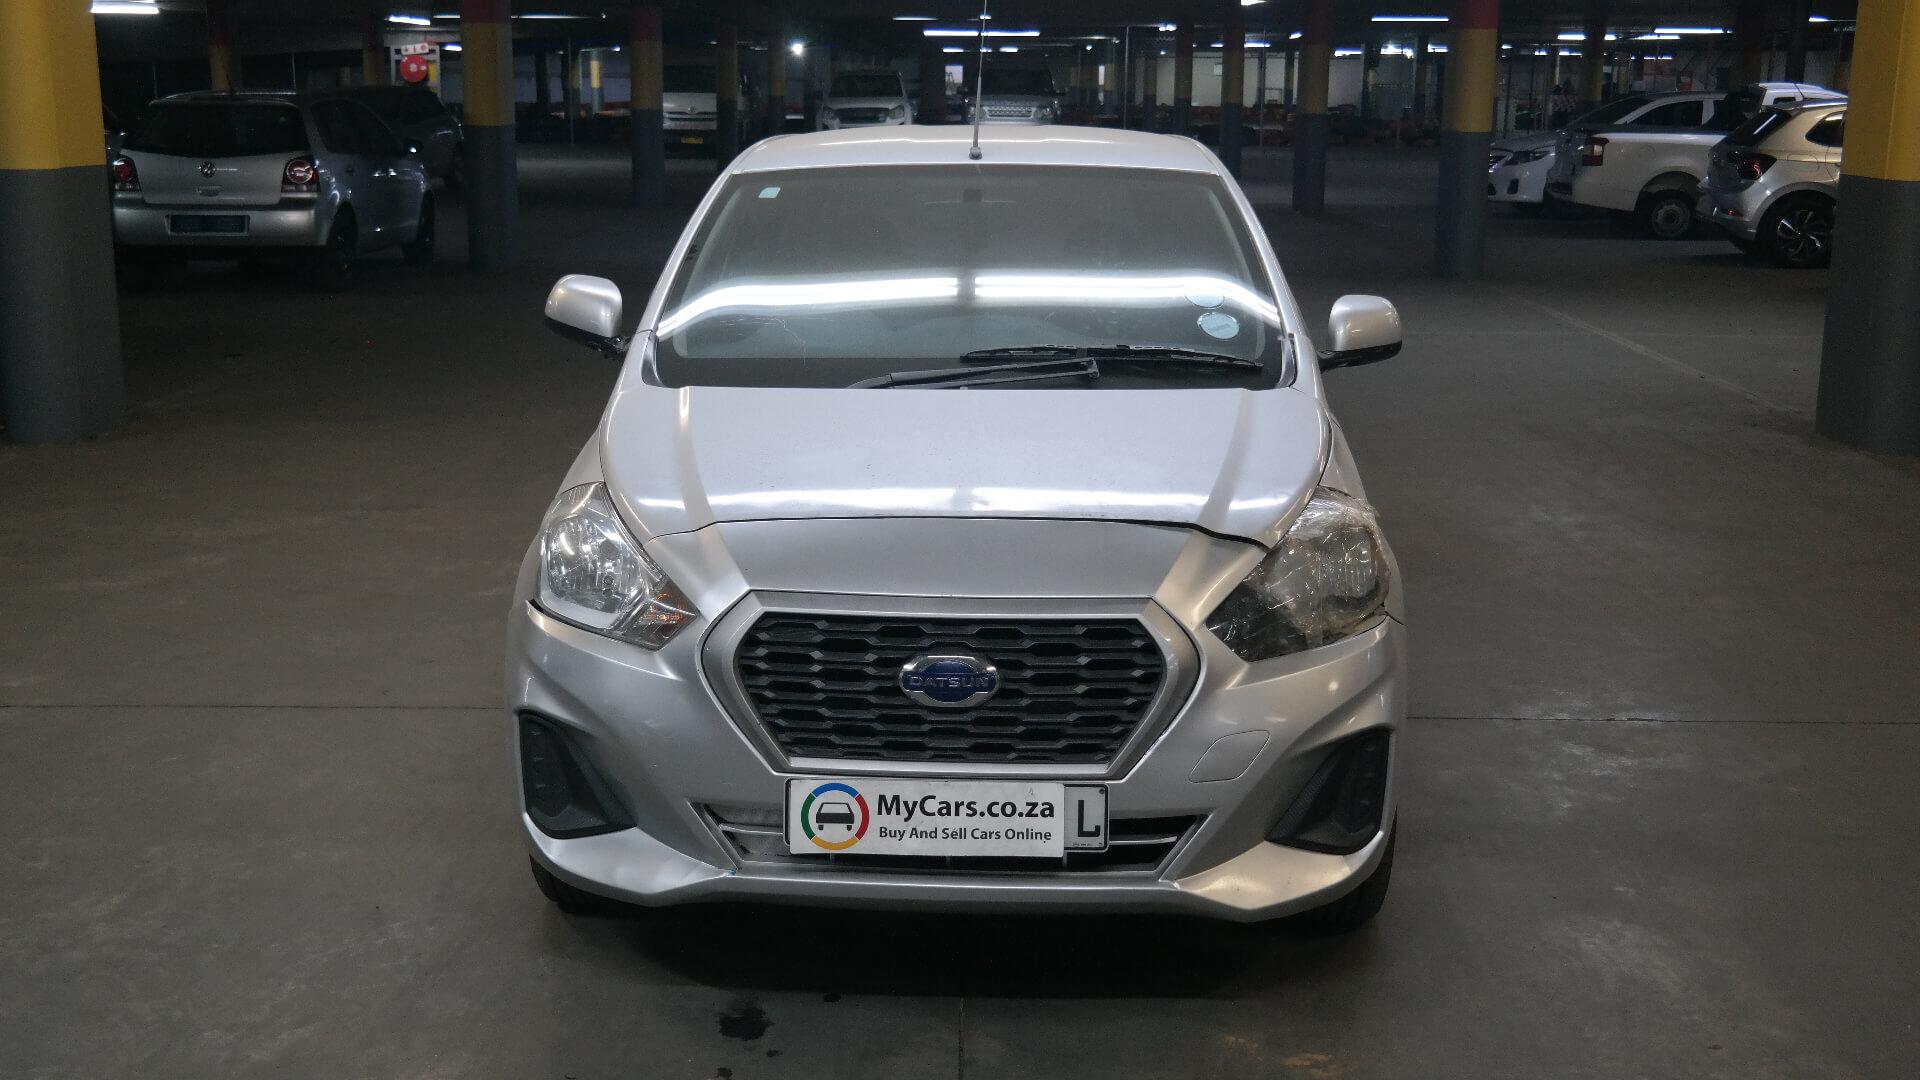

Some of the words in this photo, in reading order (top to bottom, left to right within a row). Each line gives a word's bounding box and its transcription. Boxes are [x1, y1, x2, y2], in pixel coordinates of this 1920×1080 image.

[908, 675, 990, 688] DATSUN
[877, 794, 1055, 822] MyCars.co.za
[1077, 799, 1101, 837] L
[879, 826, 905, 841] Buy
[908, 826, 938, 839] And
[941, 826, 967, 840] Sell
[970, 827, 1001, 840] Cars
[1004, 827, 1052, 841] Online
